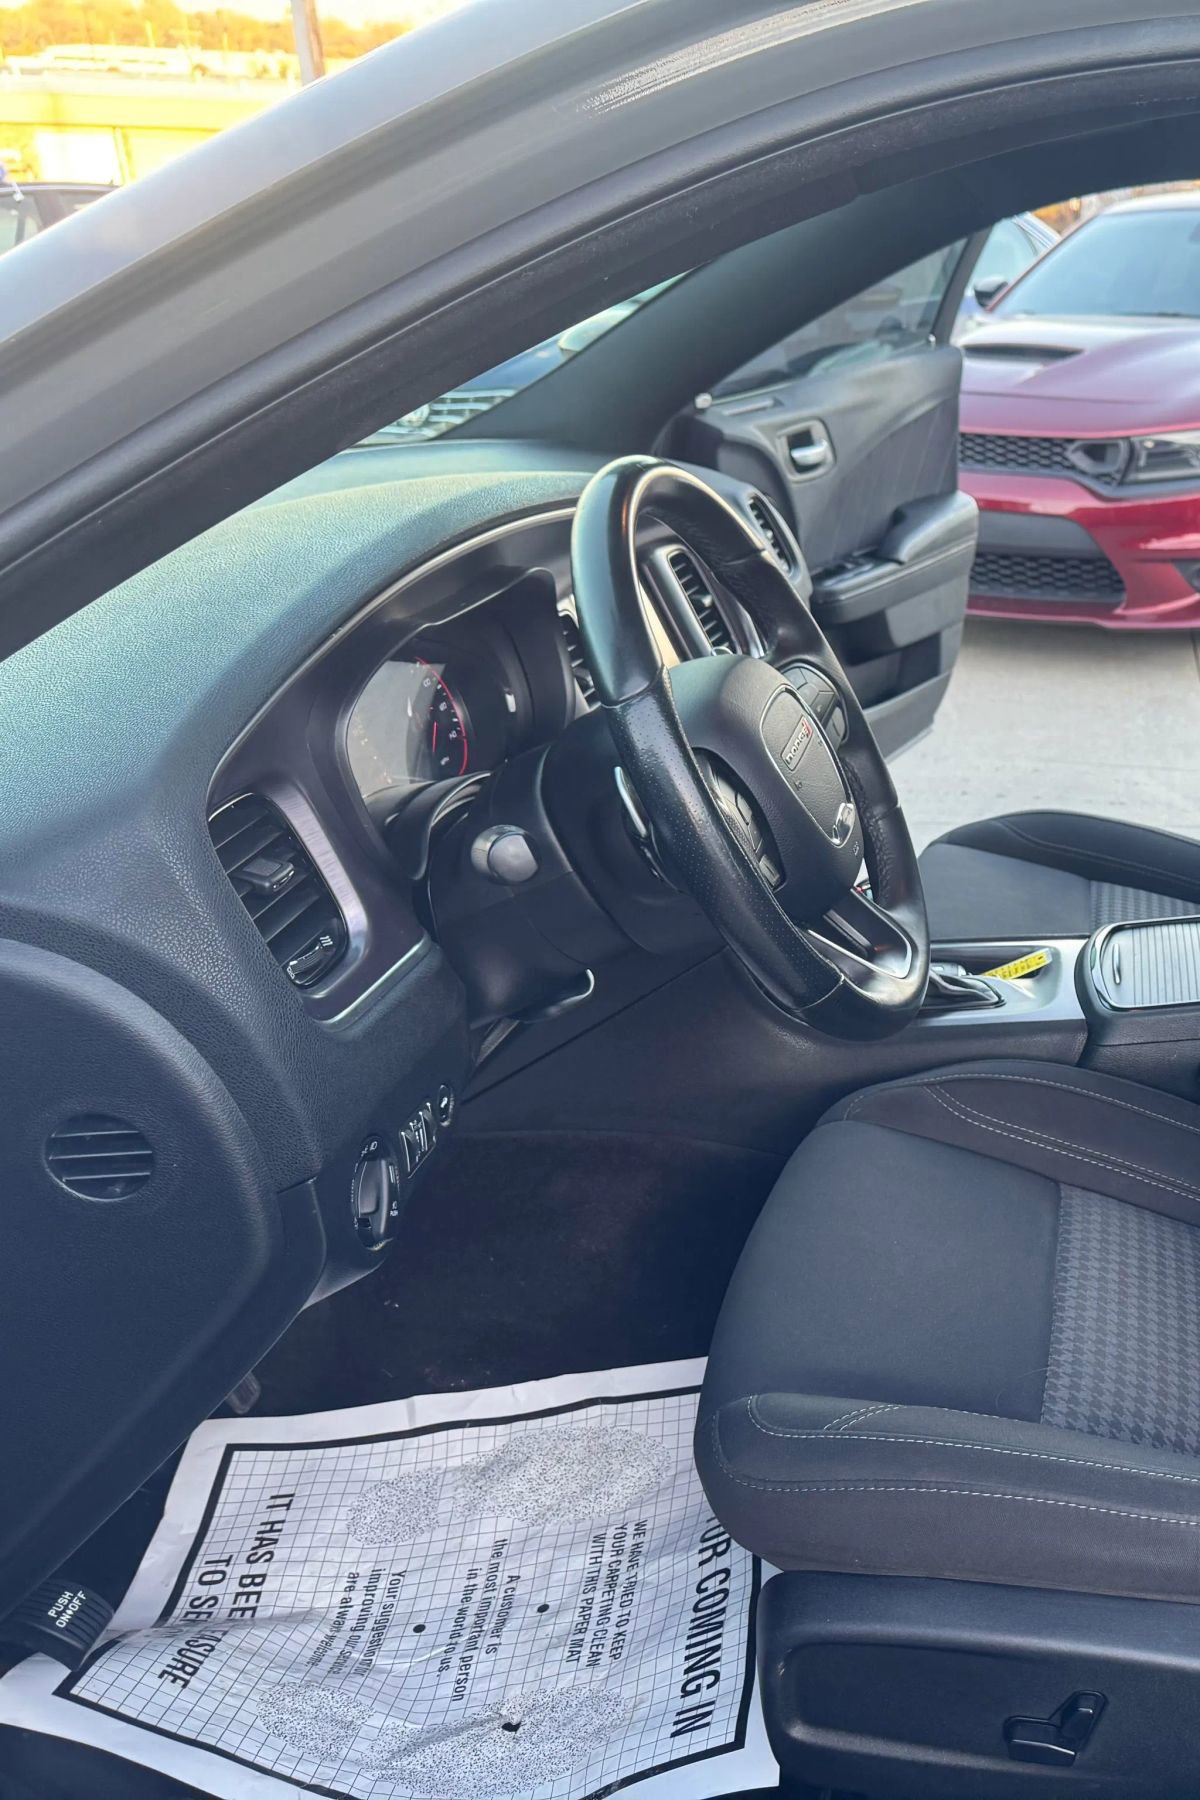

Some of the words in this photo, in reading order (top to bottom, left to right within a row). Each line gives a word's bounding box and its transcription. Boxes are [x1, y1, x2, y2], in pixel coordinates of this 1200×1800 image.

[266, 1492, 295, 1511] IT
[246, 1520, 286, 1565] HAS
[609, 1522, 628, 1557] YOUR
[632, 1520, 648, 1540] WE
[697, 1517, 732, 1567] OR
[491, 1538, 508, 1558] the
[589, 1532, 607, 1565] WITH
[626, 1541, 645, 1572] HAVE
[198, 1554, 233, 1586] TO
[344, 1572, 360, 1592] are
[386, 1570, 406, 1599] Your
[466, 1567, 482, 1580] in
[483, 1562, 501, 1593] most
[506, 1575, 521, 1584] A
[581, 1567, 602, 1595] THIS
[47, 1591, 74, 1618] PUSH
[228, 1573, 267, 1619] BEE
[350, 1568, 385, 1632] improving
[460, 1584, 478, 1604] the
[596, 1559, 622, 1626] CARPETING
[620, 1572, 638, 1608] TRIED
[330, 1597, 354, 1633] always
[449, 1606, 470, 1639] world
[464, 1596, 495, 1653] important
[489, 1587, 515, 1639] customer
[572, 1597, 594, 1635] PAPER
[615, 1610, 631, 1628] TO
[344, 1635, 362, 1649] our
[444, 1642, 458, 1654] to
[585, 1629, 608, 1667] CLEAN
[608, 1631, 628, 1660] KEEP
[680, 1567, 732, 1699] COMING
[158, 1630, 226, 1688] EASURE
[485, 1643, 502, 1655] is
[565, 1638, 584, 1665] MAT
[436, 1656, 452, 1677] us.
[452, 1655, 475, 1702] person
[670, 1701, 716, 1738] IN
